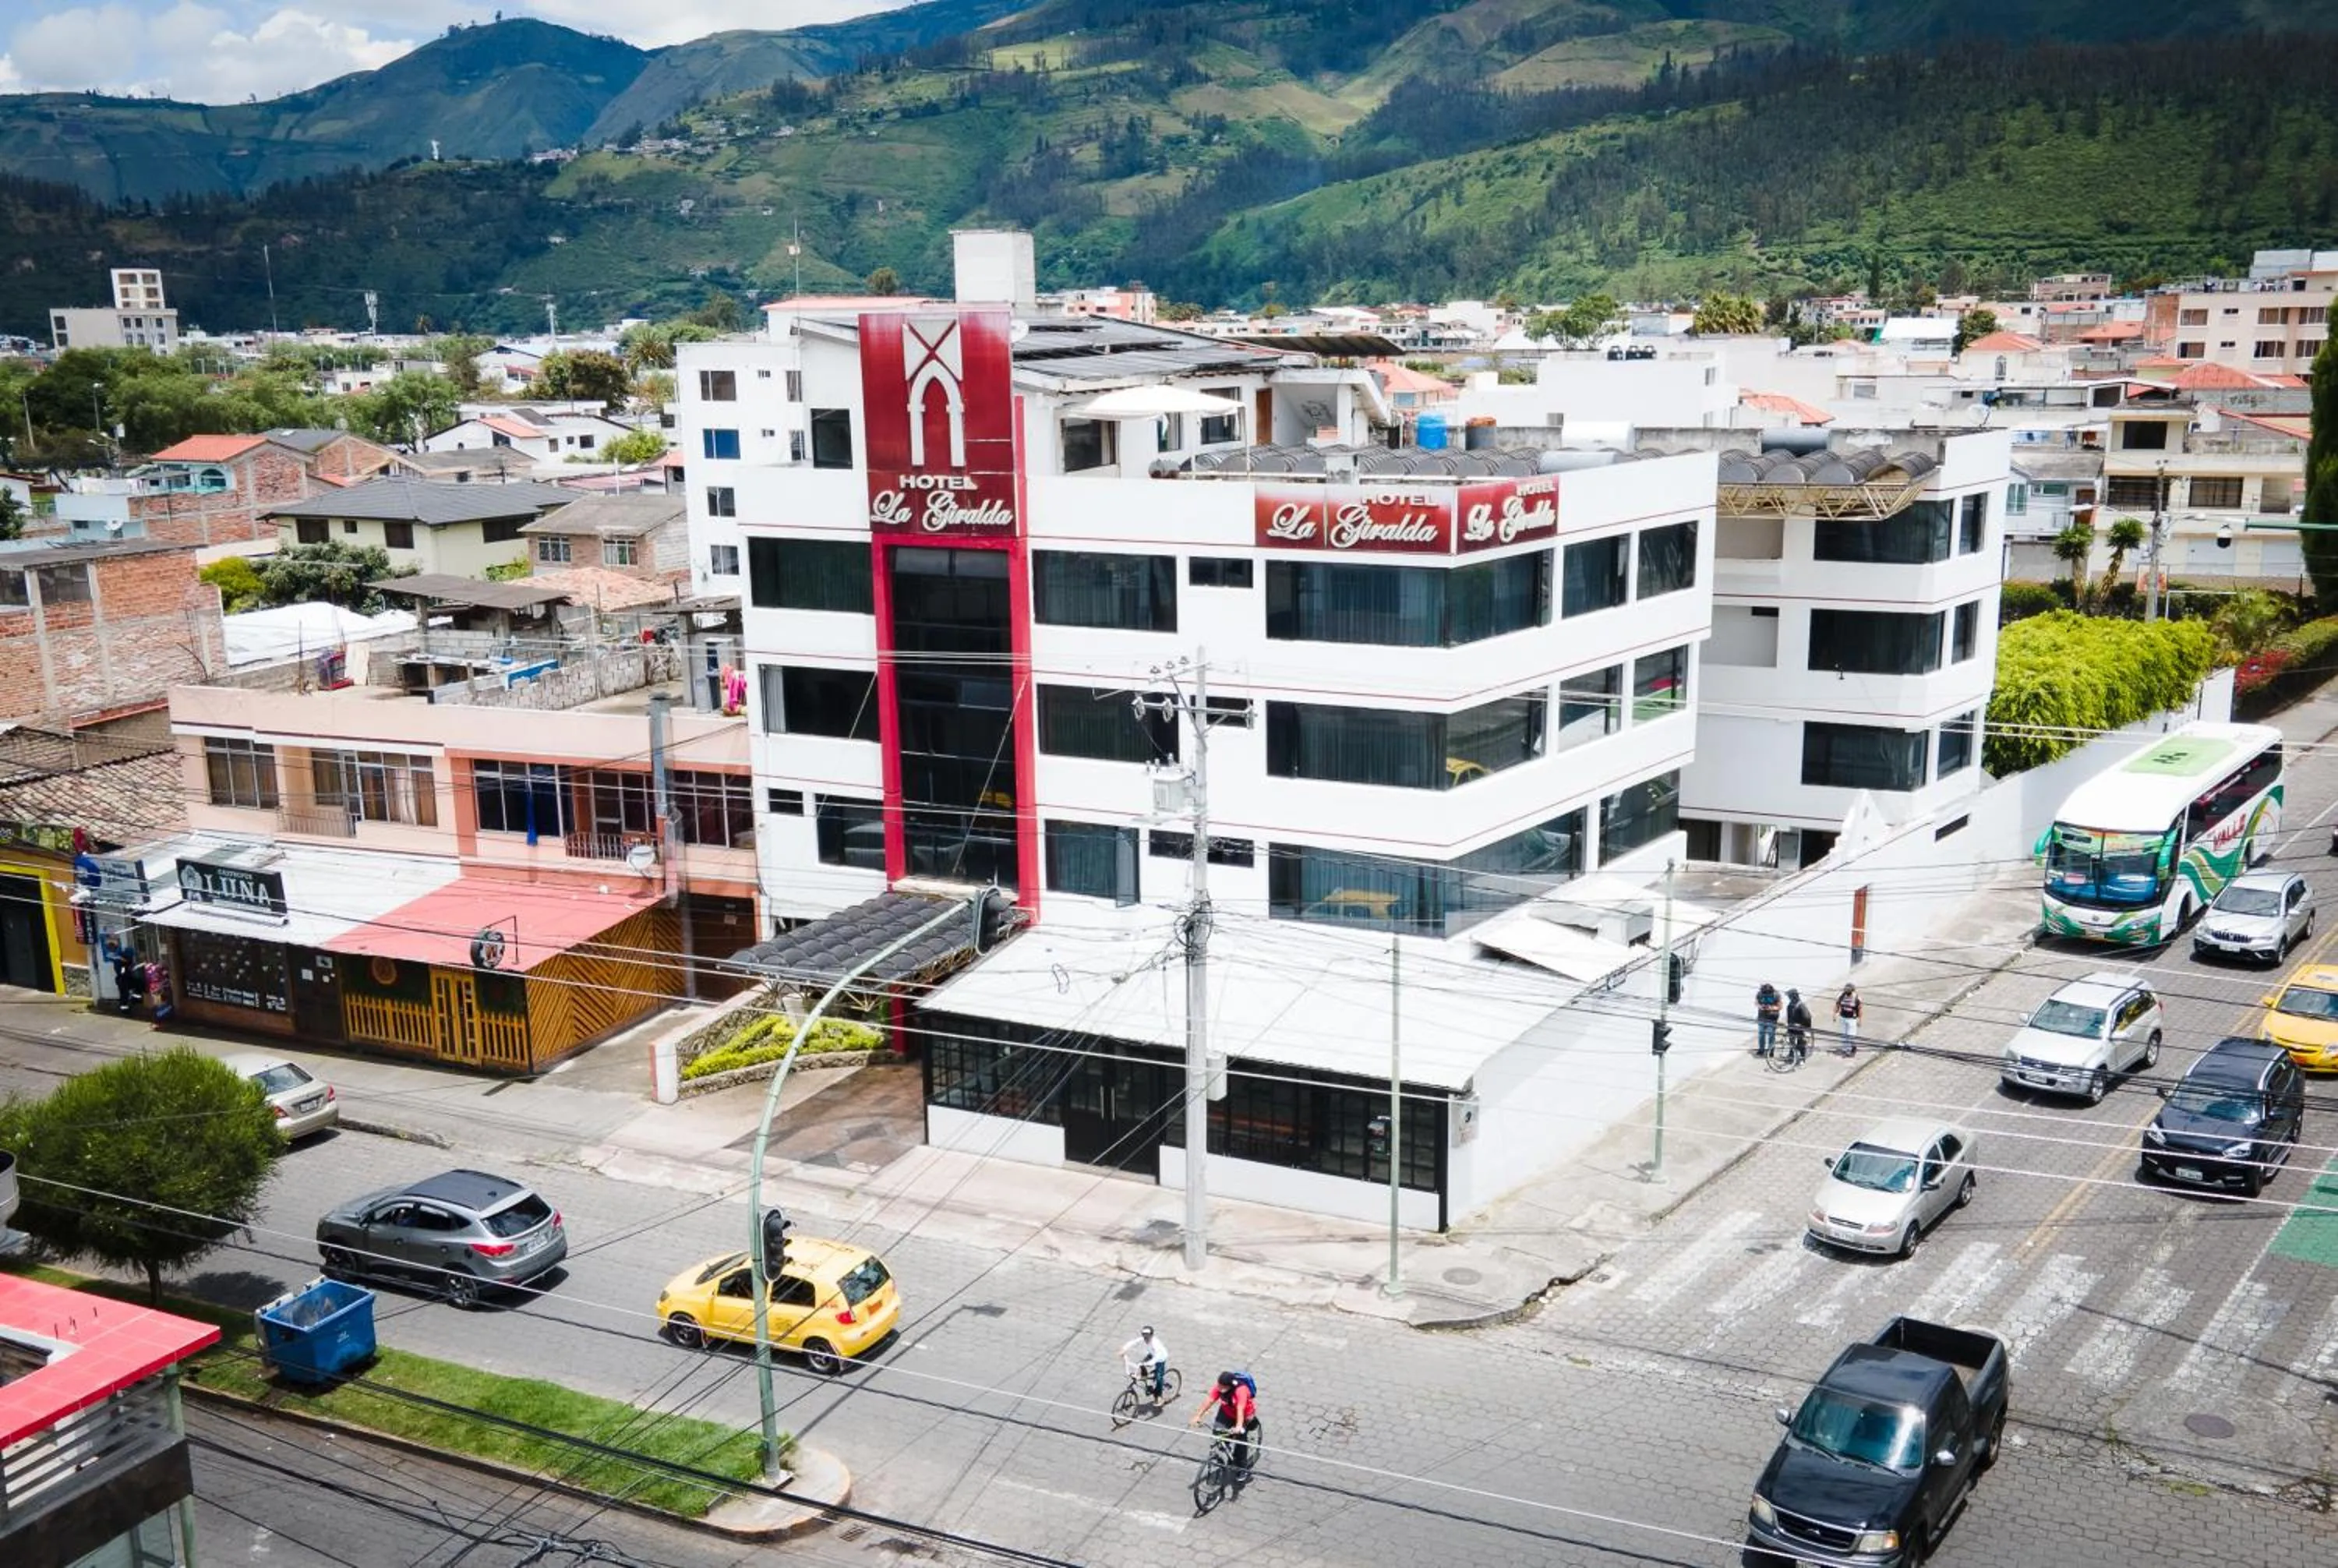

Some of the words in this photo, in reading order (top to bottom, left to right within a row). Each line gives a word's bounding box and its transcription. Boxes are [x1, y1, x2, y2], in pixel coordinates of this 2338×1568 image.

[899, 475, 978, 490] HOTEL
[1517, 483, 1556, 496] HOTEL
[871, 490, 912, 524] La
[922, 490, 1013, 531] Giralda
[1361, 493, 1438, 507] HOTEL
[1266, 503, 1317, 540] La
[1330, 503, 1438, 548] Giralda
[203, 874, 271, 906] LUNA
